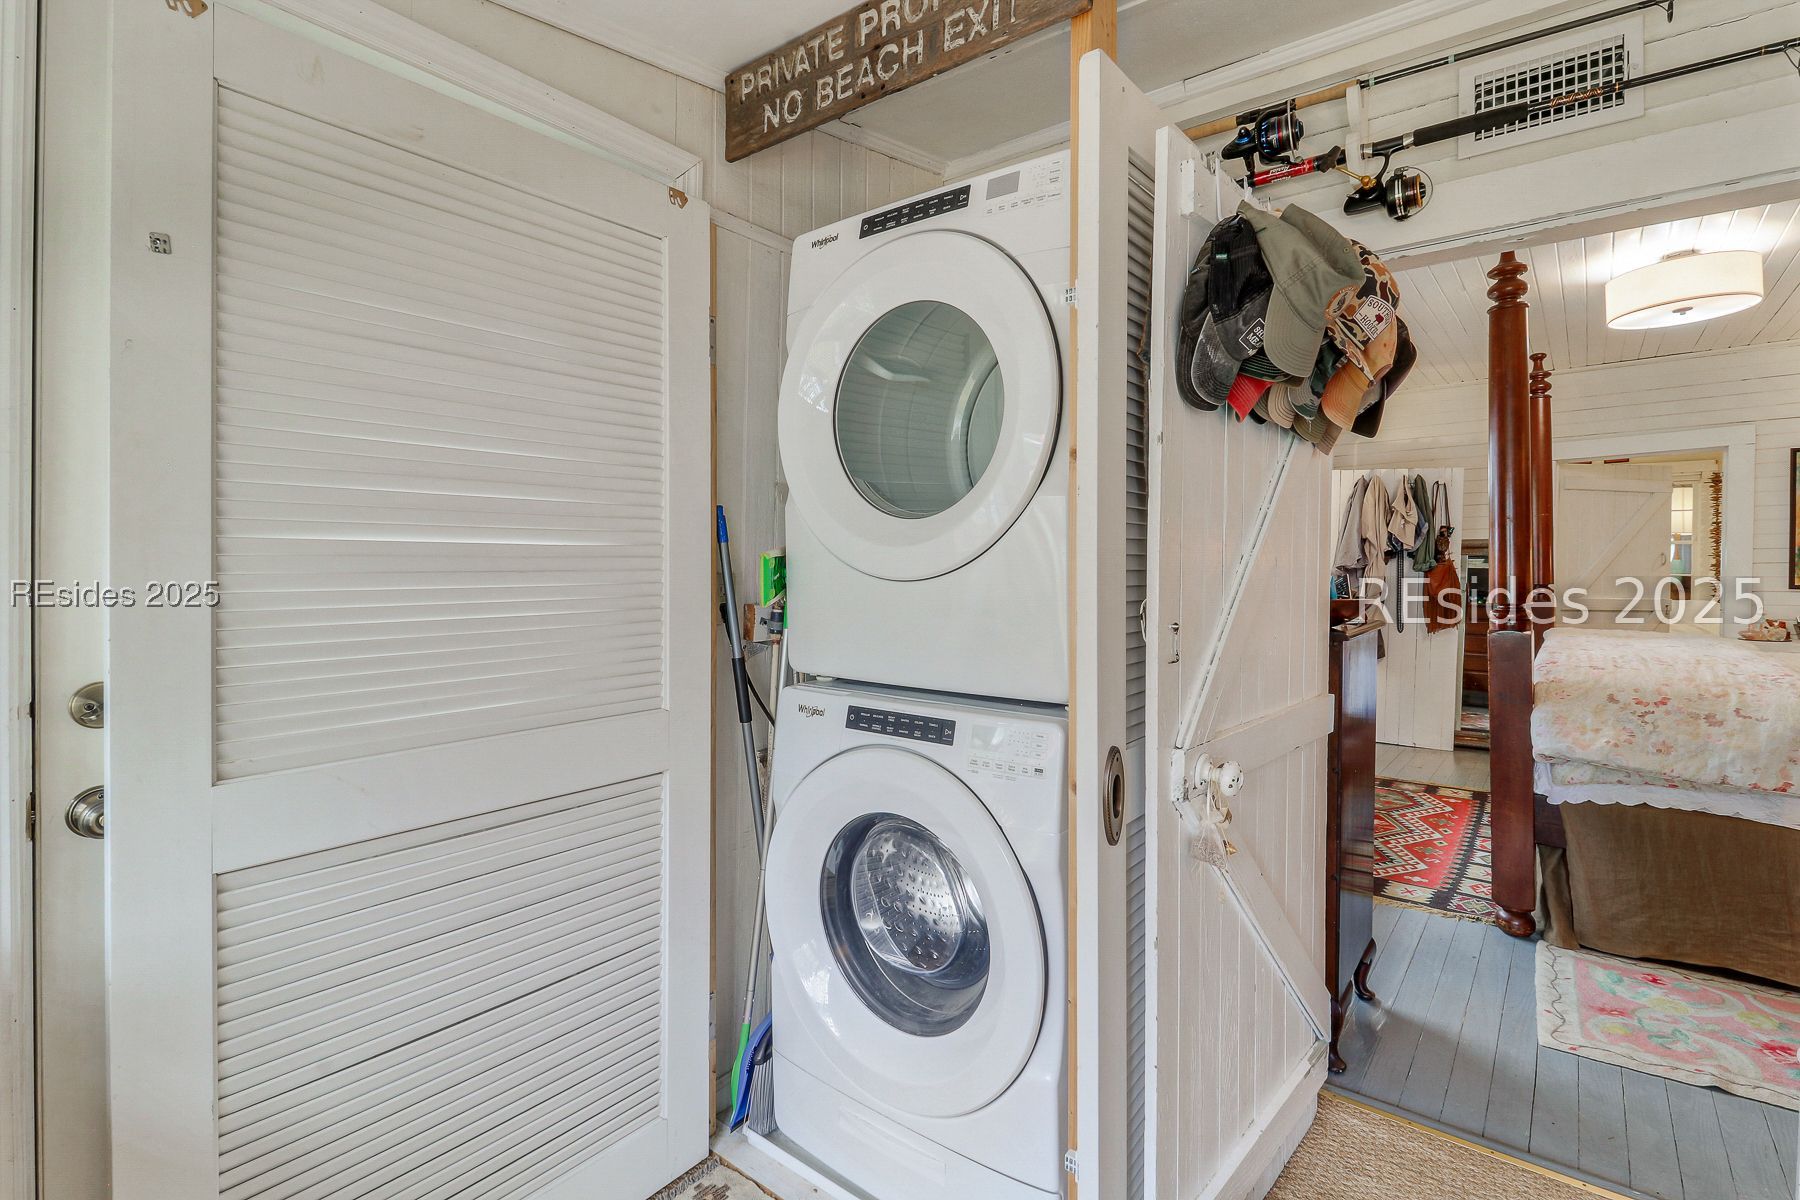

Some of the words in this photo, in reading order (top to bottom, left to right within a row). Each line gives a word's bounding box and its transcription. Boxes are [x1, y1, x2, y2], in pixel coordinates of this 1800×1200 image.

[741, 25, 844, 102] PRIVATE
[763, 89, 803, 133] NO
[815, 29, 924, 111] BEACH
[811, 232, 839, 249] Whirlpool
[1367, 299, 1391, 325] SOUTH
[798, 703, 826, 718] Whirlpool
